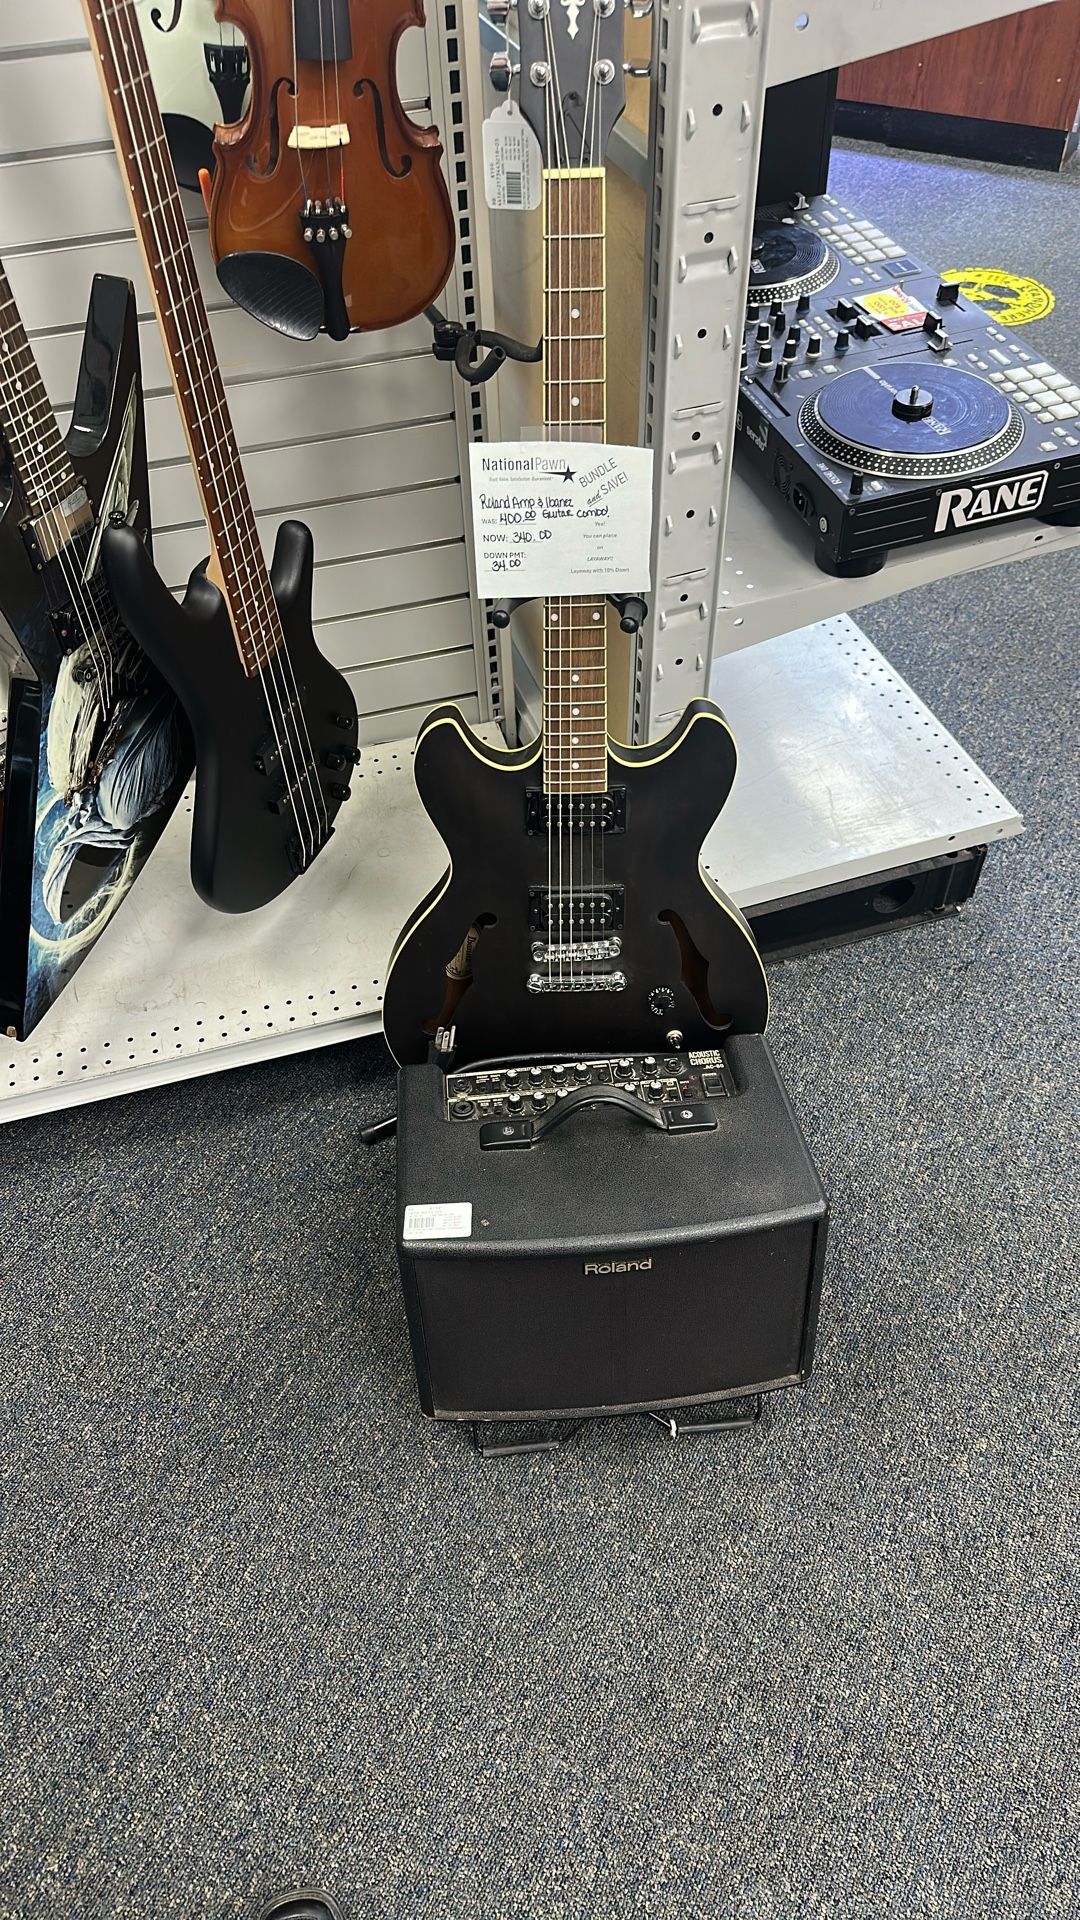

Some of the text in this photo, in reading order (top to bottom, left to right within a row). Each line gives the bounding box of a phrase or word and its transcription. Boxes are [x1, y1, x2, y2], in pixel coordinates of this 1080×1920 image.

[482, 457, 566, 471] NationalPawn
[578, 457, 618, 488] BUNDLE
[587, 471, 628, 506] and SAVE!
[512, 496, 535, 510] Amp
[545, 496, 573, 508] Ibanez
[934, 476, 1043, 533] RANE
[482, 534, 508, 542] NOW:
[688, 1049, 721, 1059] ACOUSTIC
[689, 1056, 722, 1066] CHORUS
[584, 1258, 653, 1275] Roland
